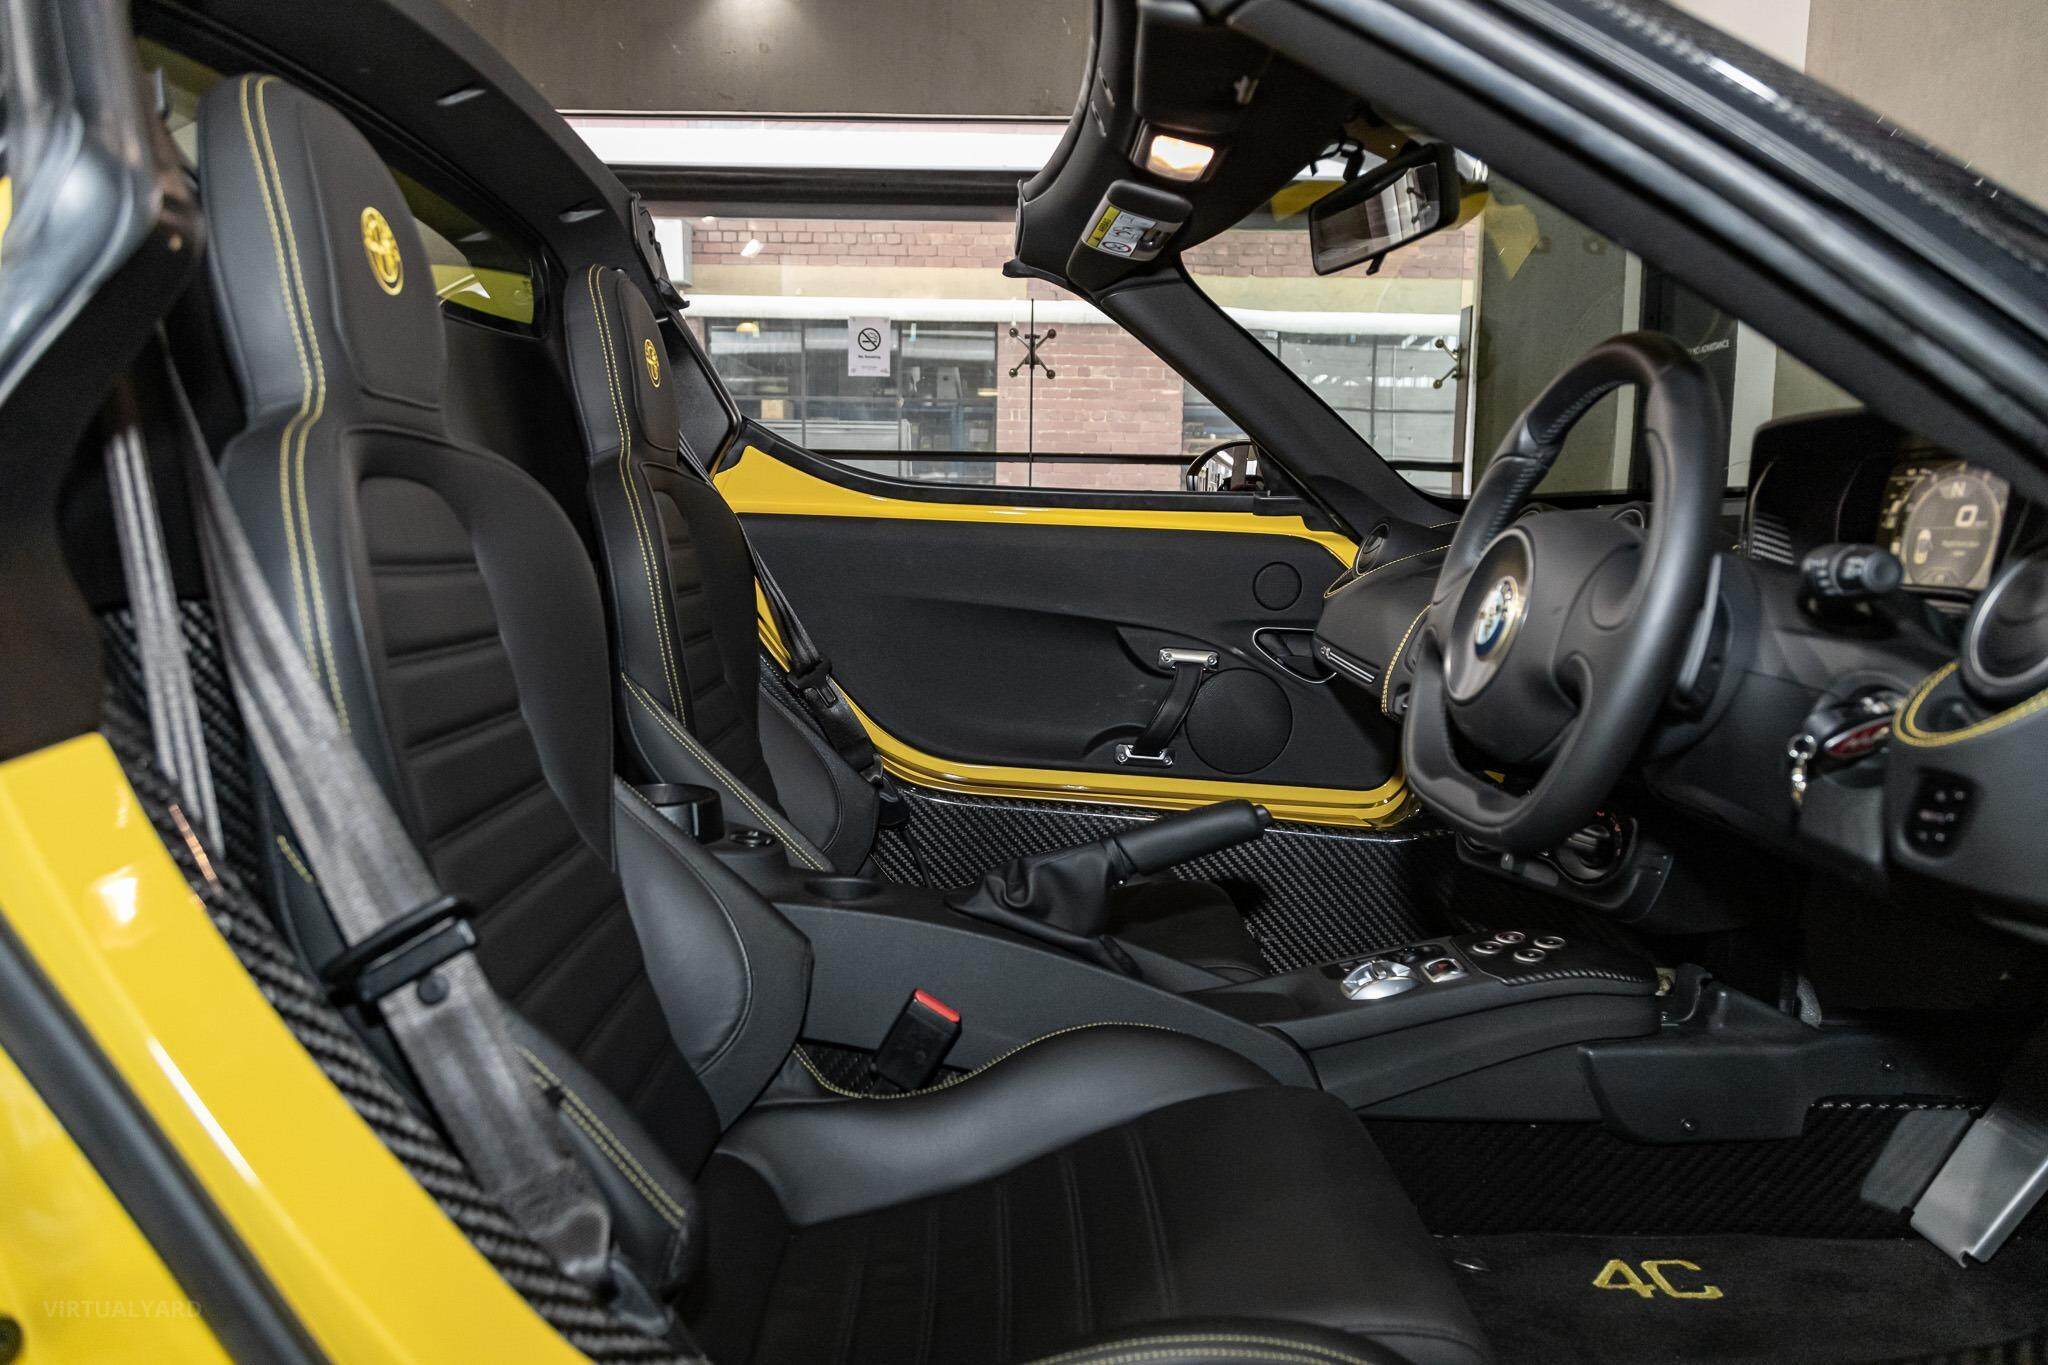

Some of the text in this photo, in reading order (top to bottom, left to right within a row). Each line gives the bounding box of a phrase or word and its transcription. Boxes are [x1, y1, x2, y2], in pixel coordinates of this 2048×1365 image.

[1950, 480, 1967, 499] N
[1955, 504, 1979, 528] 0
[1592, 1259, 1723, 1299] 4C
